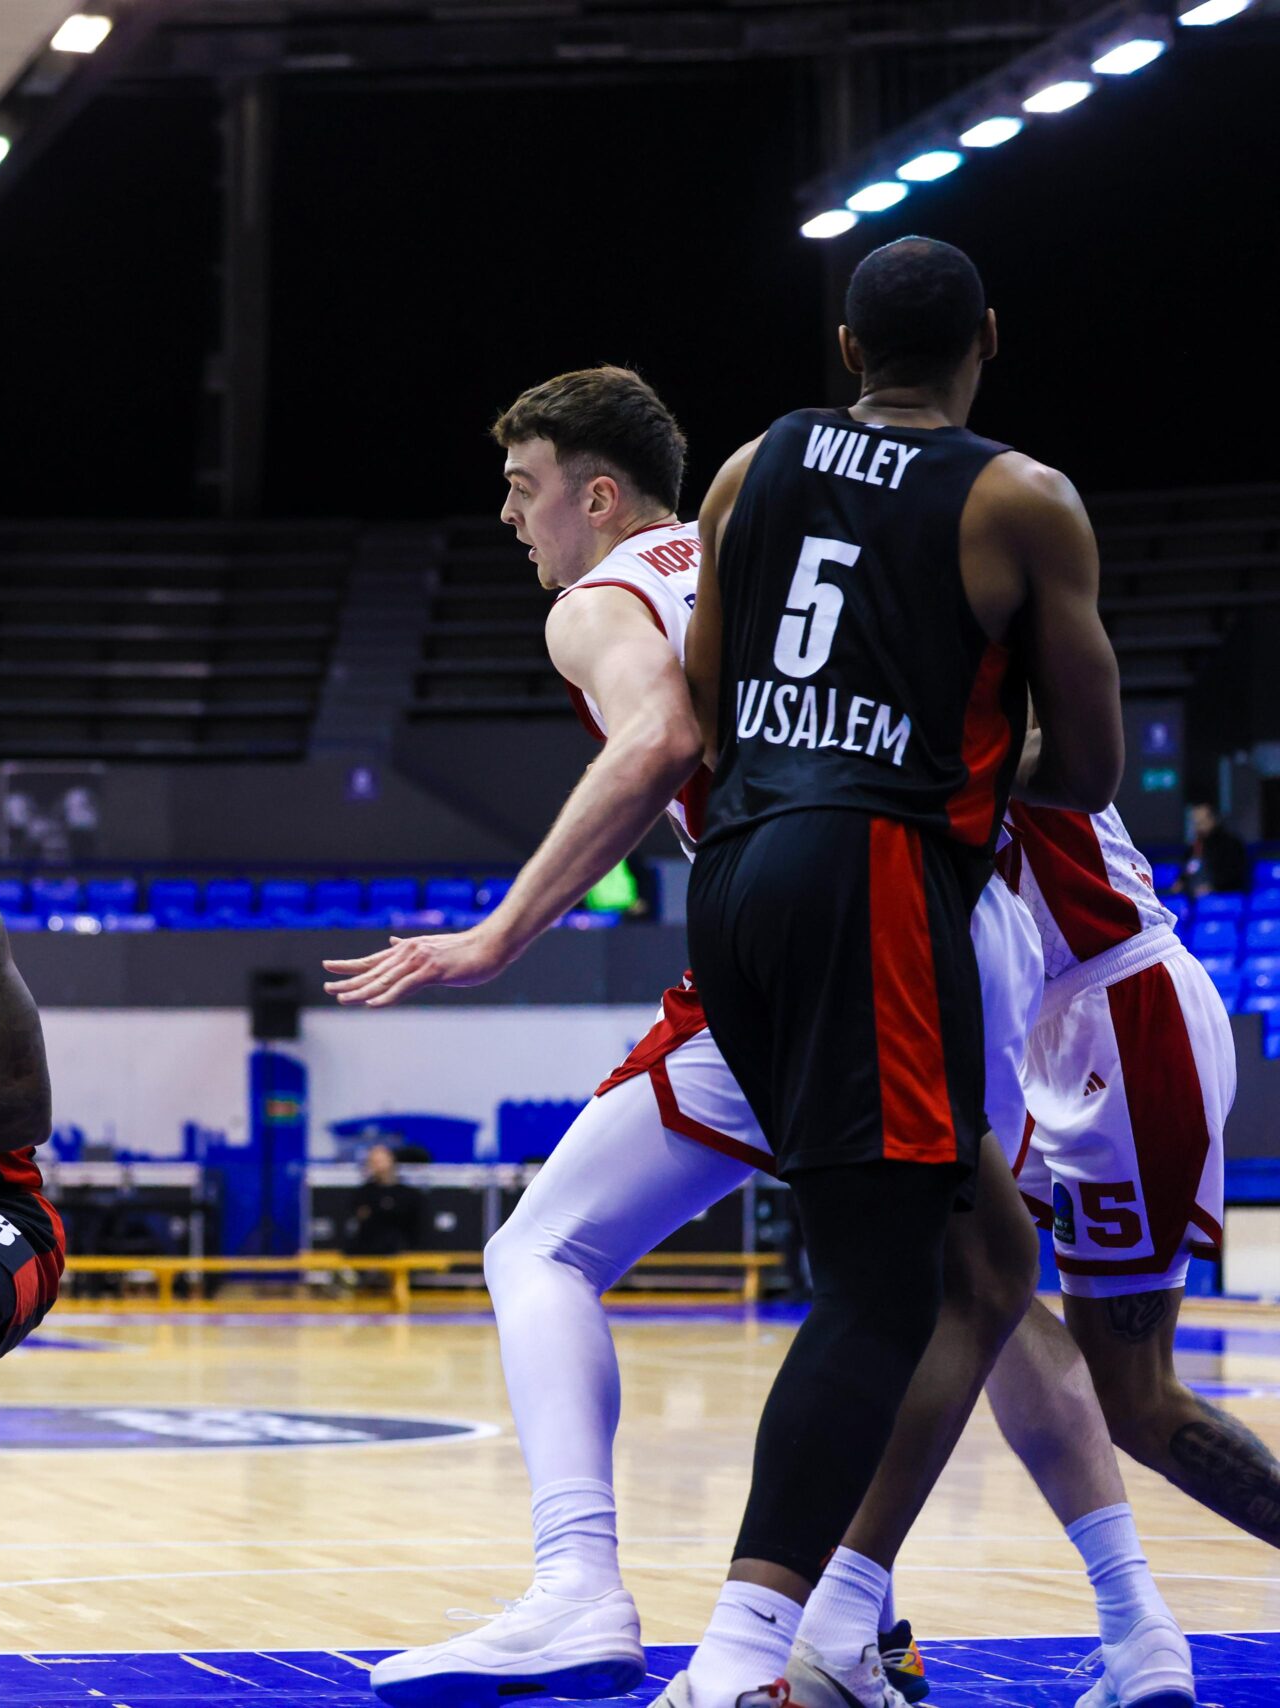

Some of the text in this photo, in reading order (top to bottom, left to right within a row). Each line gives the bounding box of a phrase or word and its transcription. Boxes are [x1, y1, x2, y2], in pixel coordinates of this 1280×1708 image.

[803, 425, 922, 490] WILEY
[774, 536, 862, 679] 5
[737, 680, 912, 766] USALEM
[1078, 1180, 1143, 1248] 5
